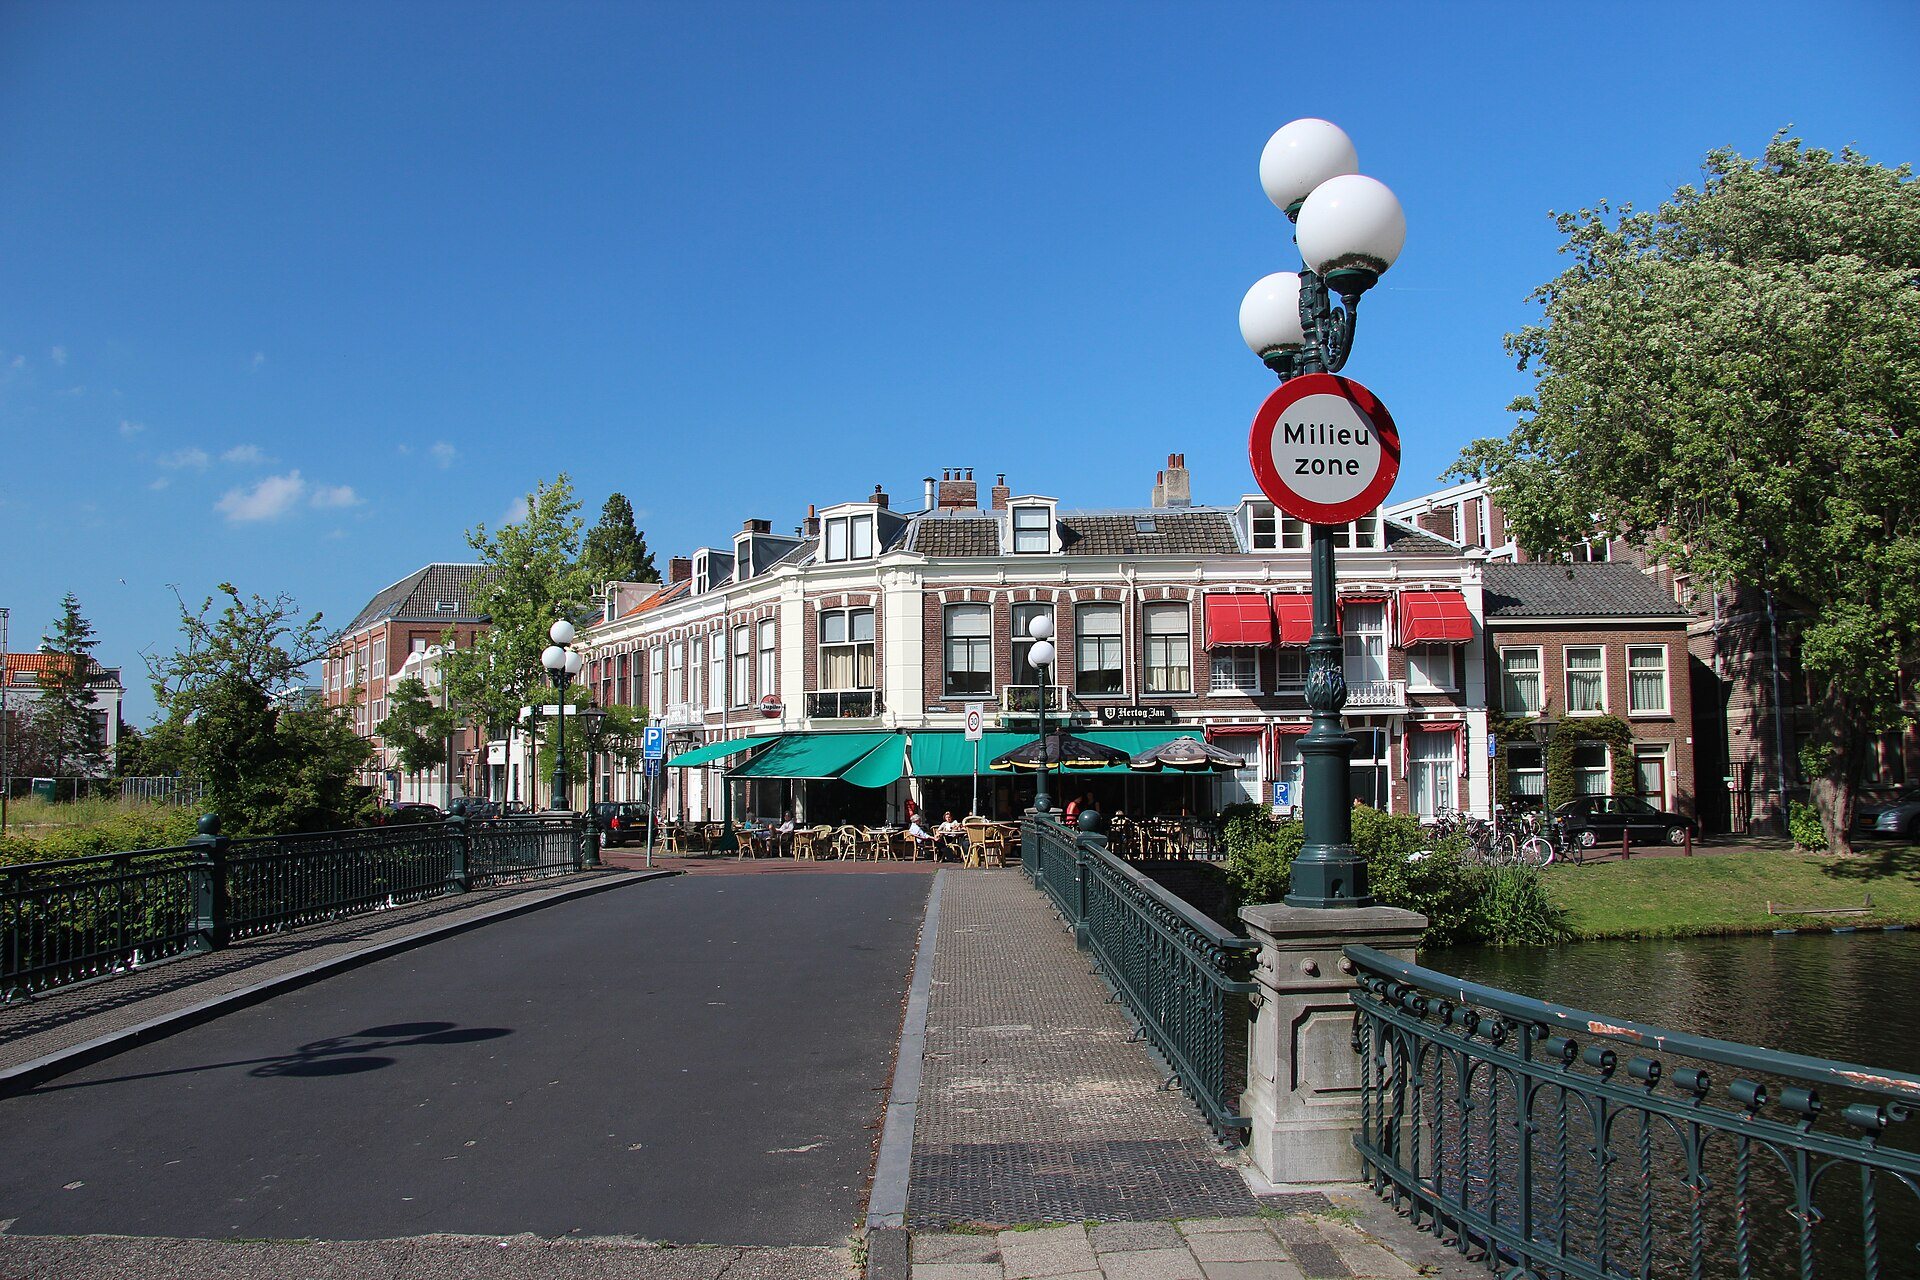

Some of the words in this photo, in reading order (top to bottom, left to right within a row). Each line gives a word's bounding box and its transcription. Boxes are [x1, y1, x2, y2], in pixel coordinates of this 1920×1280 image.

[1284, 423, 1369, 446] Milieu
[1295, 458, 1359, 475] zone
[1117, 707, 1147, 719] Hertog
[1148, 707, 1165, 719] Jan
[970, 717, 978, 726] 30
[648, 729, 659, 746] P
[1277, 784, 1286, 796] P
